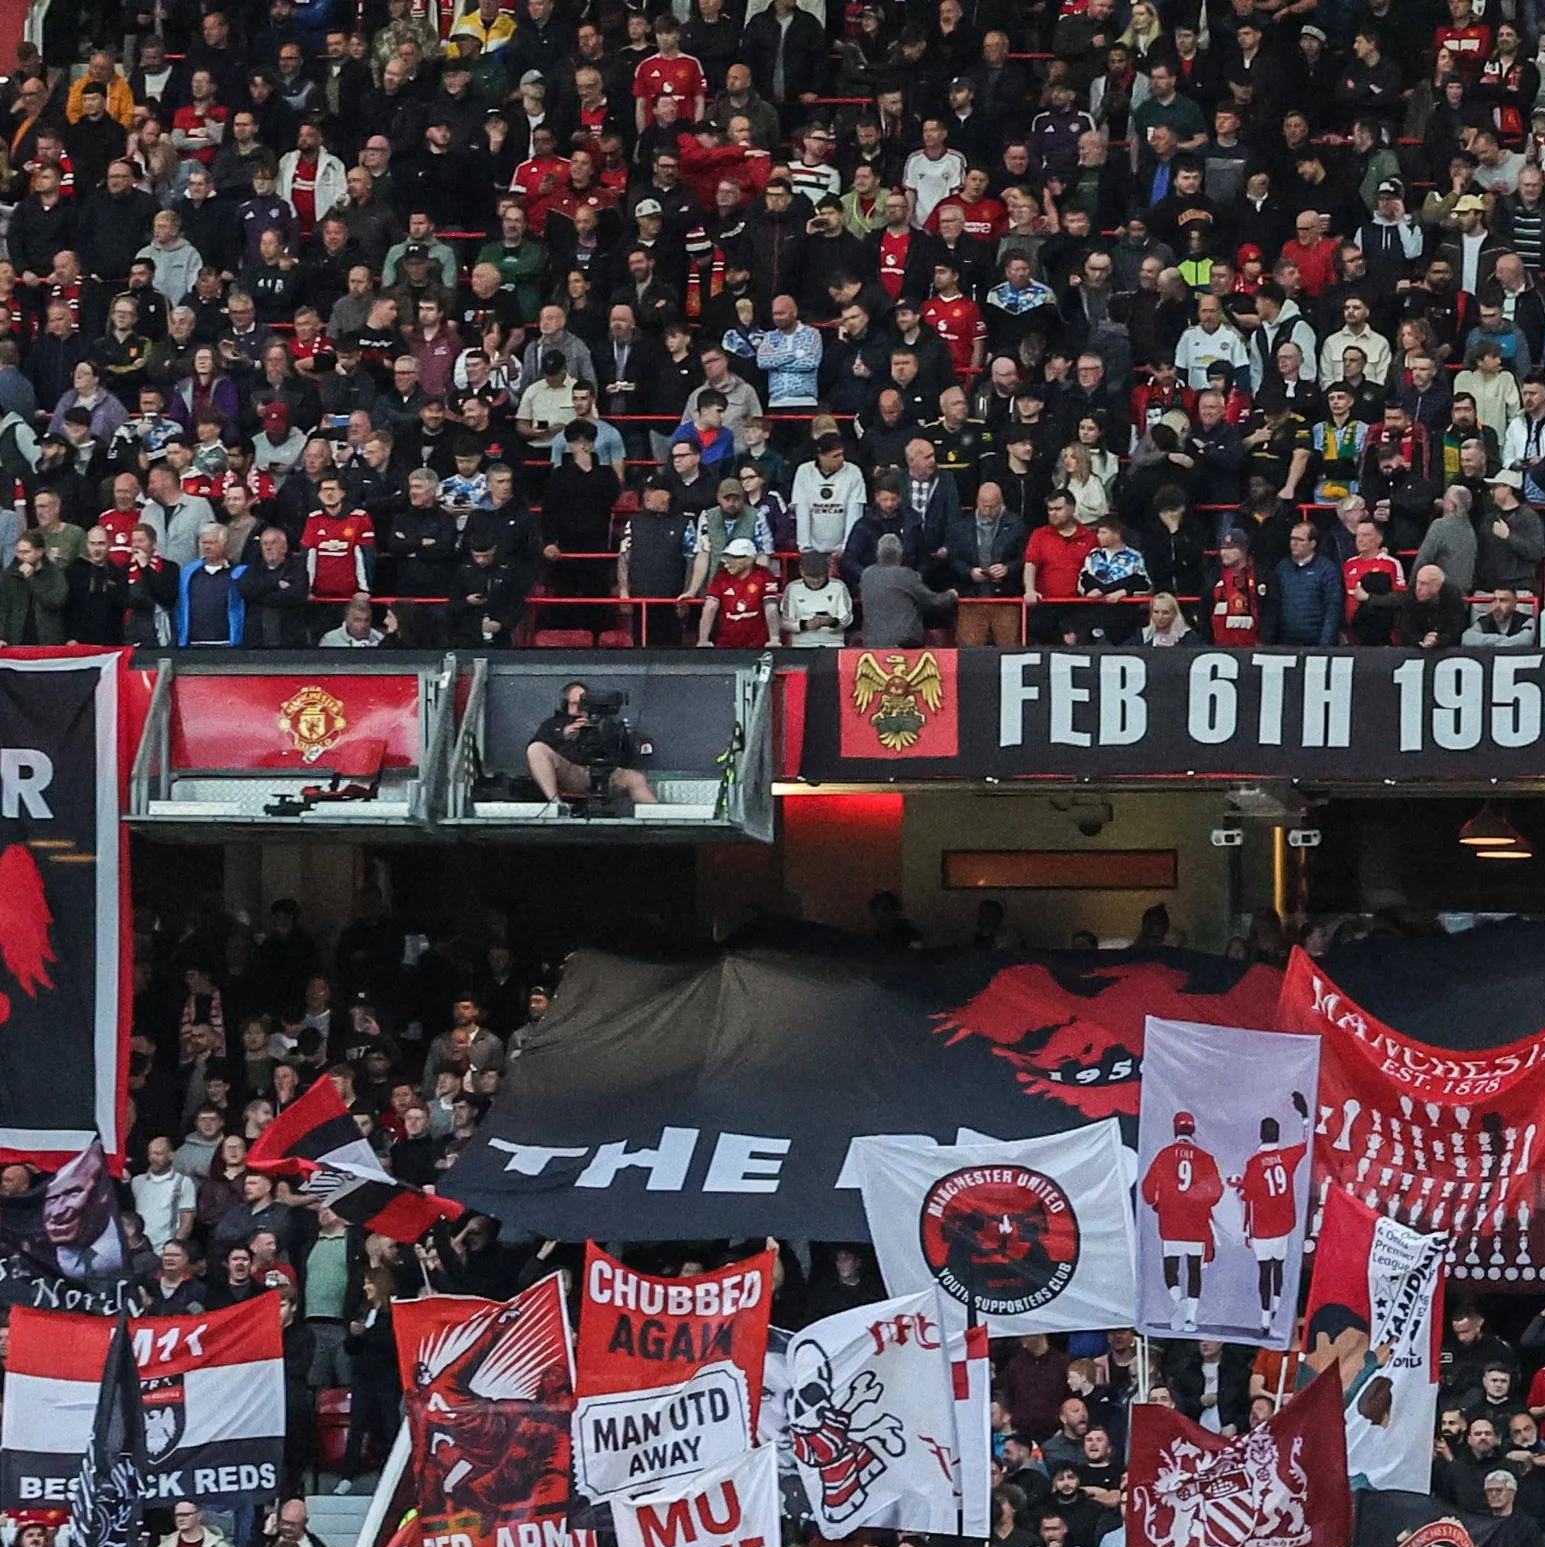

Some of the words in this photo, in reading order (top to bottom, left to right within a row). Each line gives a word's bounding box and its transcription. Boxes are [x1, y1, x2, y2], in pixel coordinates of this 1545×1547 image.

[1000, 653, 1148, 747] FEB
[1187, 653, 1354, 748] 6TH
[1047, 1057, 1142, 1084] 195
[1379, 1057, 1433, 1092] EST.
[1443, 1076, 1503, 1097] 1878
[486, 1125, 792, 1194] THE
[1177, 1160, 1192, 1192] 9
[1263, 1165, 1288, 1197] 19
[926, 1169, 1014, 1218] MANCHESTER
[1016, 1173, 1066, 1214] UNITED
[1372, 1251, 1411, 1273] League
[589, 1259, 762, 1317] CHUBBED
[973, 1286, 1053, 1314] SUPPORTERS
[1047, 1261, 1073, 1293] CLUB
[608, 1314, 737, 1364] AGAIN
[592, 1410, 662, 1454] MAN
[669, 1387, 730, 1431] UTD
[628, 1435, 701, 1477] AWAY
[19, 1470, 186, 1500] BESCK
[194, 1462, 276, 1495] REDS
